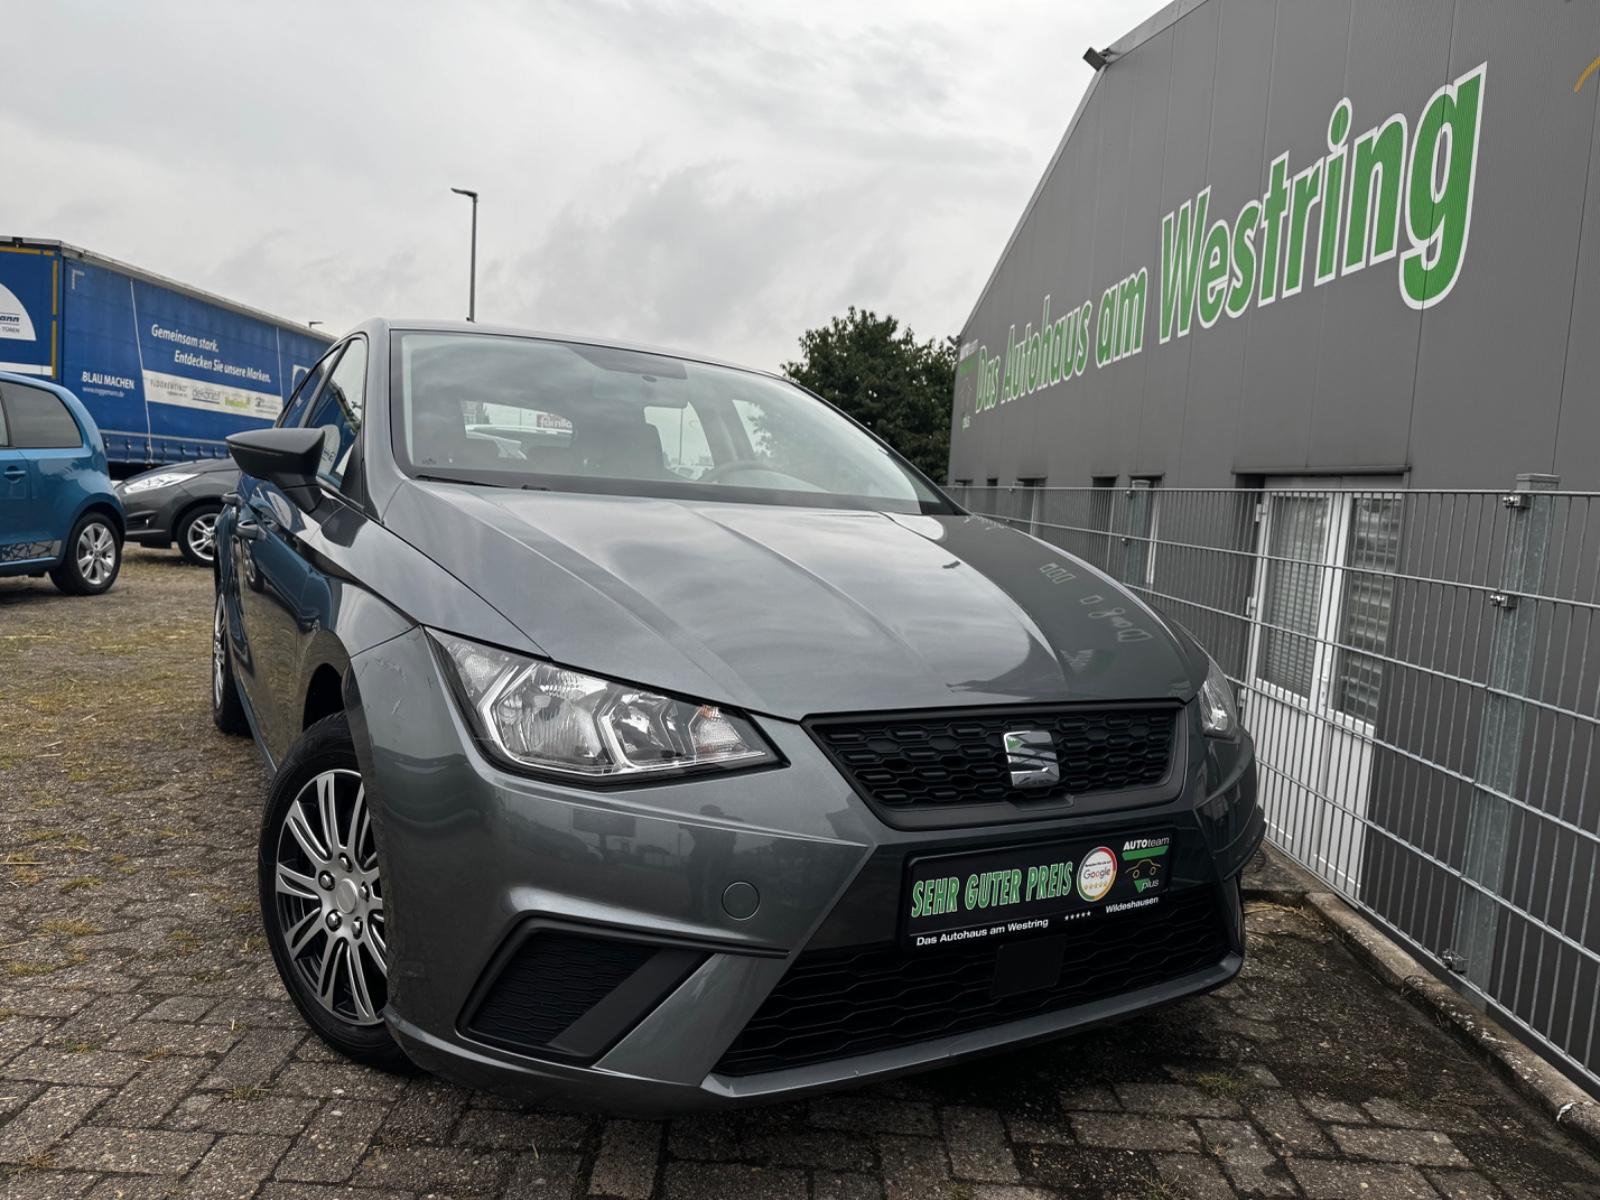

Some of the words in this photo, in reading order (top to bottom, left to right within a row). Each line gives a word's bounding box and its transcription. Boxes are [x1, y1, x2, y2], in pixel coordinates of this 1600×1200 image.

[975, 345, 1001, 414] Das
[1001, 295, 1092, 405] Autohaus
[1096, 267, 1147, 369] am
[1158, 61, 1488, 345] Westring
[151, 323, 198, 347] Gemeinsam
[199, 338, 219, 353] stark.
[82, 370, 103, 385] BLAU
[104, 374, 135, 390] MACHEN
[174, 350, 213, 371] Entdecken
[213, 359, 224, 373] Sie
[224, 362, 246, 377] unsere
[246, 367, 271, 384] Marken.
[1123, 836, 1170, 851] AUTOteam
[1083, 866, 1111, 880] Google
[911, 876, 960, 918] SEHR
[964, 868, 1022, 911] GUTER
[1026, 861, 1073, 902] PREIS
[1105, 896, 1159, 914] Wildeshausen
[916, 936, 938, 946] Das
[939, 927, 988, 943] Autohaus
[990, 926, 1006, 936] am
[1007, 917, 1049, 932] Westring
